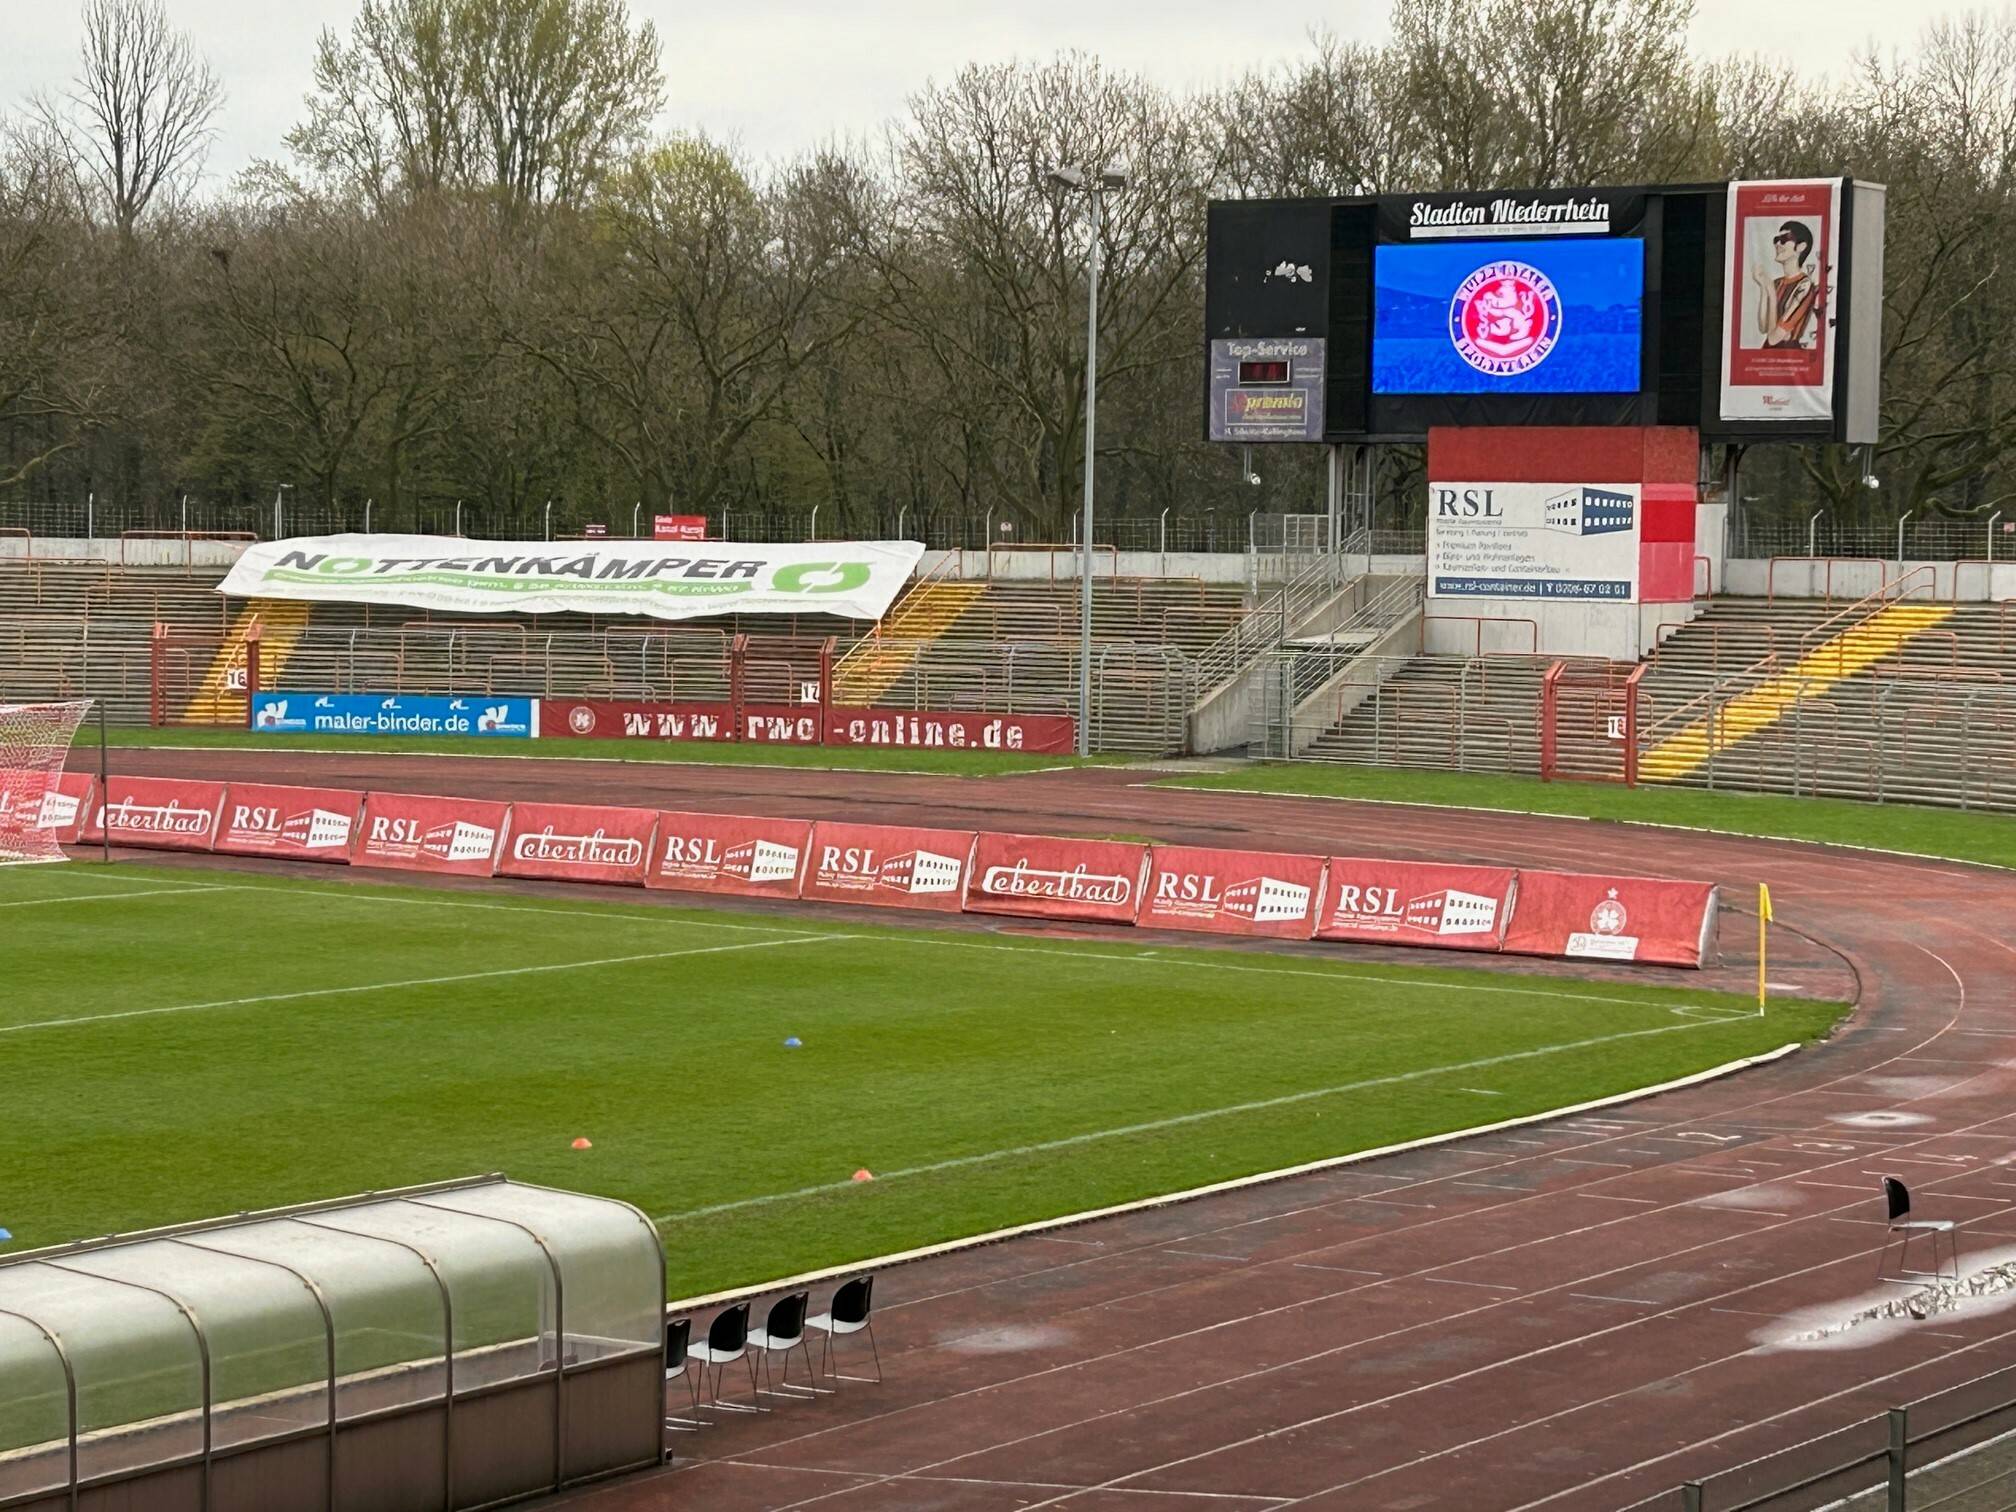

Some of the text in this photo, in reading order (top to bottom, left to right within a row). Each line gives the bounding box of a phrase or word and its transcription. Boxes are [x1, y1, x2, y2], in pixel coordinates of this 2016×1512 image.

[1410, 201, 1486, 226] Stadion
[1490, 196, 1610, 224] Niederrhein
[1227, 341, 1308, 359] Top-Service
[1438, 489, 1503, 517] RSL
[273, 550, 768, 579] NOTTENKÄMPER
[1491, 564, 1507, 573] und
[229, 671, 247, 687] 16
[803, 684, 819, 700] 17
[314, 711, 470, 733] maler-binder.de
[105, 794, 208, 833] ebertbad
[231, 805, 282, 831] RSL
[370, 816, 423, 844] RSL
[523, 824, 638, 865] ebertbad
[665, 835, 721, 864] RSL
[820, 845, 880, 875] RSL
[994, 857, 1126, 903] ebertbad
[1156, 871, 1222, 902] RSL
[1337, 884, 1405, 916] RSL
